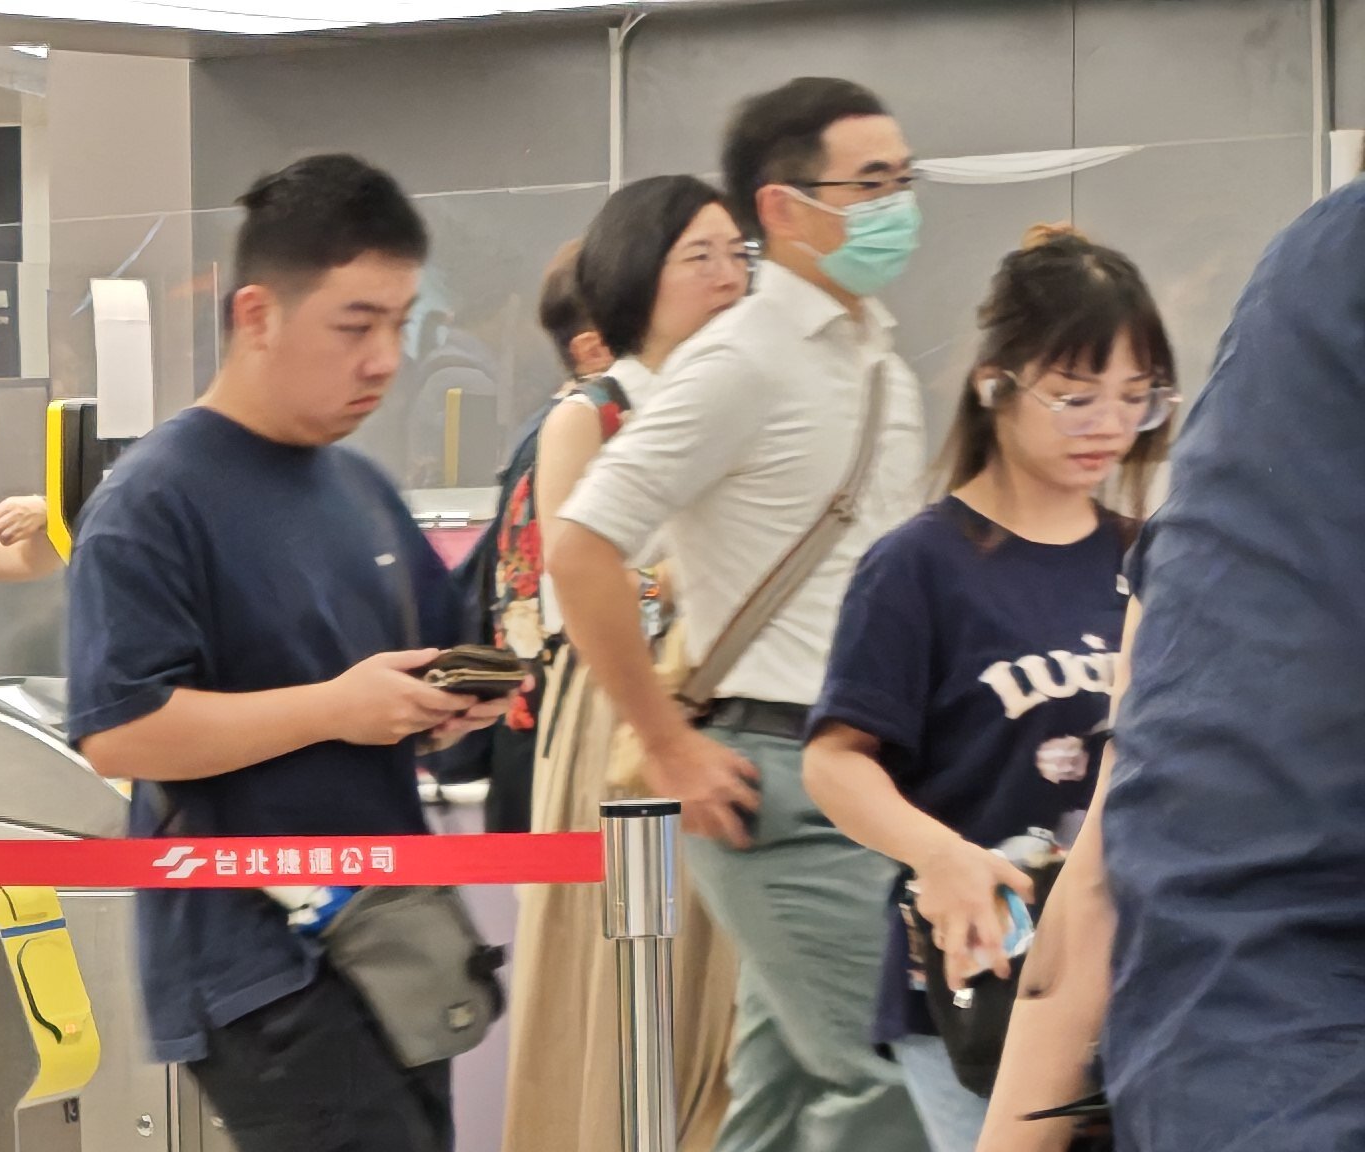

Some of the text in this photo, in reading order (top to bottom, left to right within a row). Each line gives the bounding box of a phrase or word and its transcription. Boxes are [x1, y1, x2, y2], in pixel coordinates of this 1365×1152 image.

[214, 847, 394, 875] 台北捷運公司
